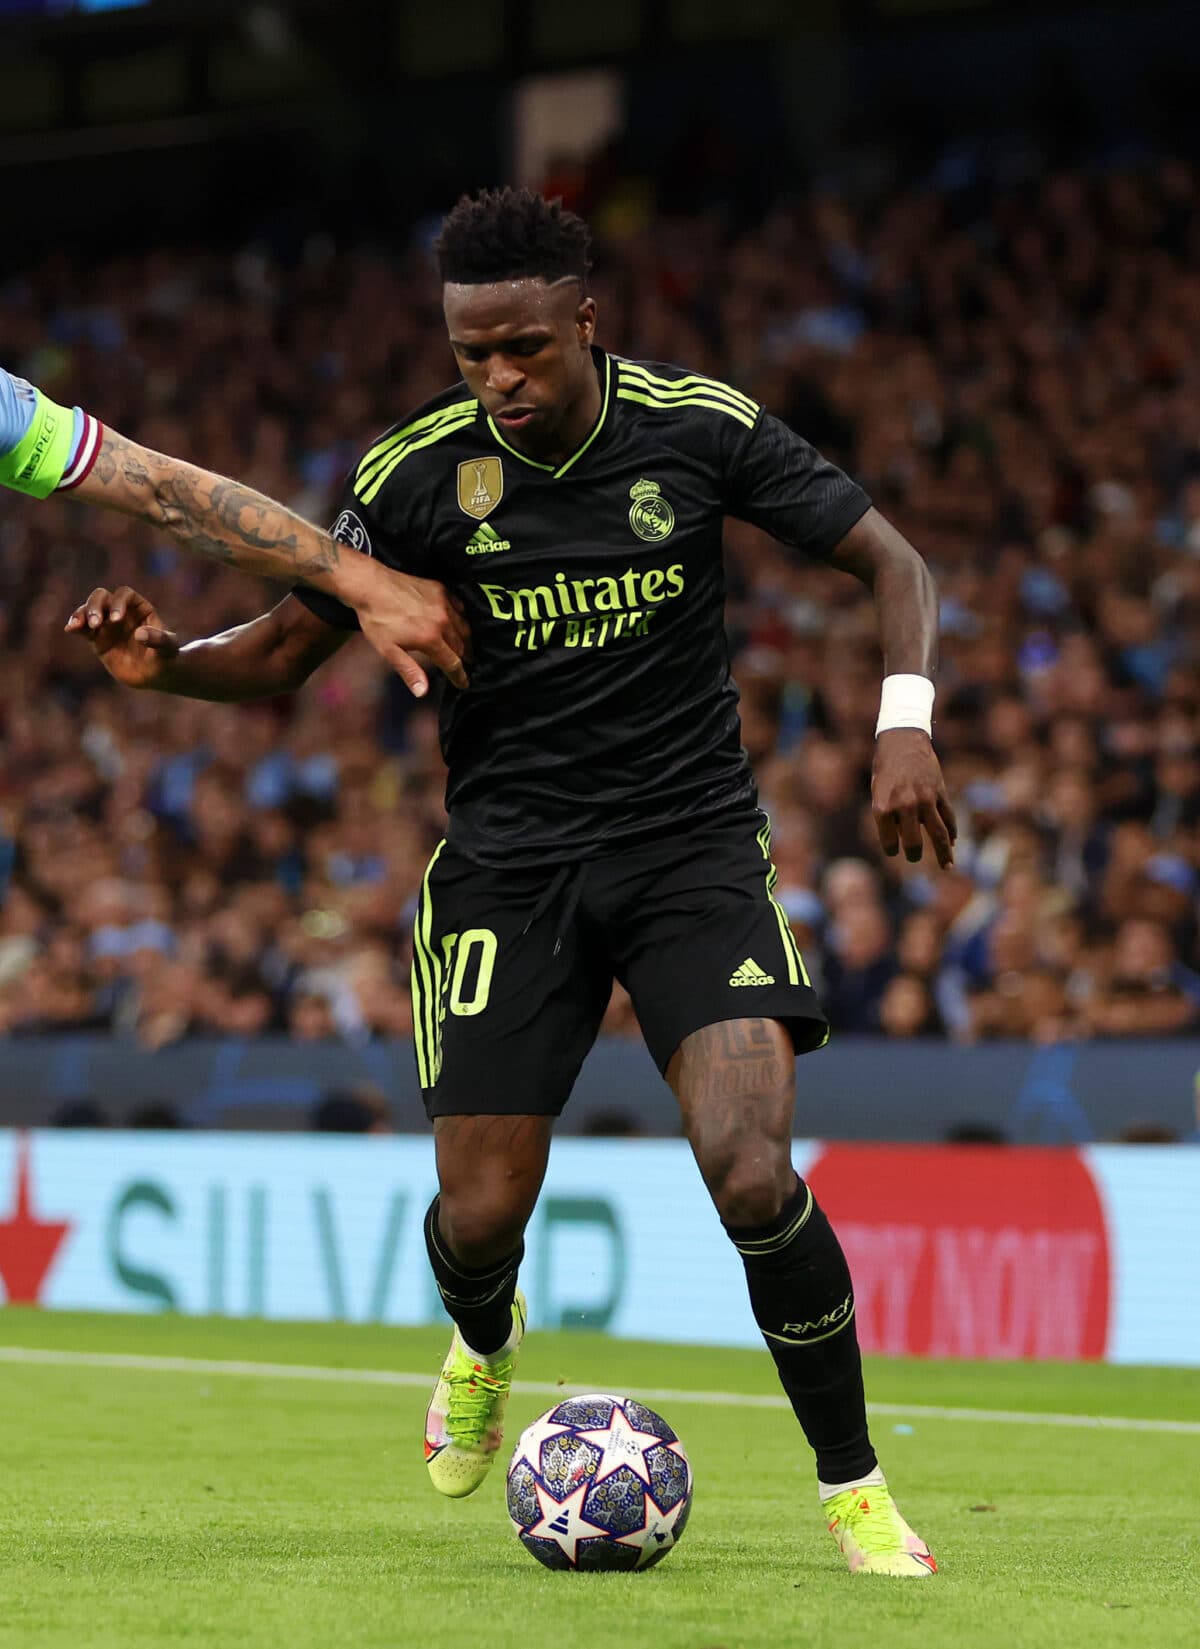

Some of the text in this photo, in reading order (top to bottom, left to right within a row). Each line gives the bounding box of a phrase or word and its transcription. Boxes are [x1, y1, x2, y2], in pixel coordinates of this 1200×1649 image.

[20, 415, 56, 480] RESPECT
[471, 495, 491, 505] FIFA
[465, 540, 511, 555] adidas
[479, 564, 685, 622] Emirates
[514, 610, 657, 650] FLY BETTER
[729, 975, 776, 988] adidas
[782, 1292, 852, 1334] RMCF
